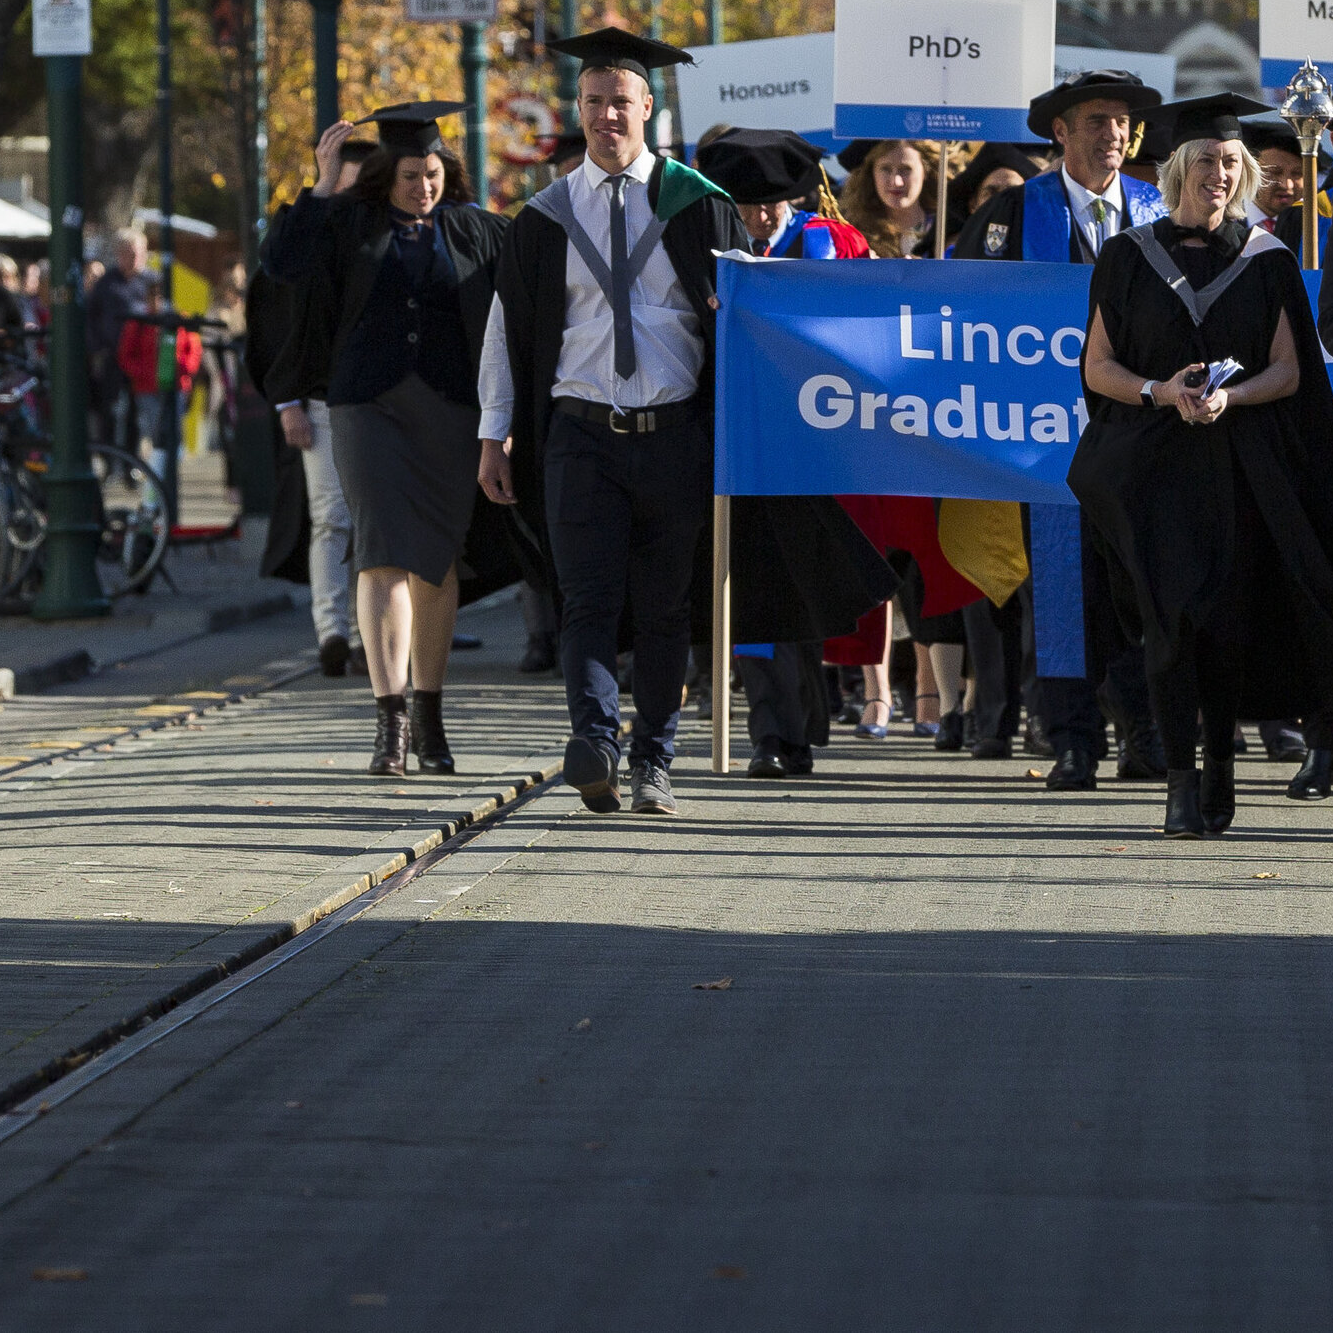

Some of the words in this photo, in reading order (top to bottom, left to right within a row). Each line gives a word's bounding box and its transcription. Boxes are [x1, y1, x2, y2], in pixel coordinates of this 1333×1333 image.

[718, 77, 811, 102] Honours
[926, 113, 966, 121] LINCOLN
[926, 120, 982, 128] UNIVERSITY
[899, 304, 1087, 367] Linco
[798, 374, 1091, 443] Graduat
